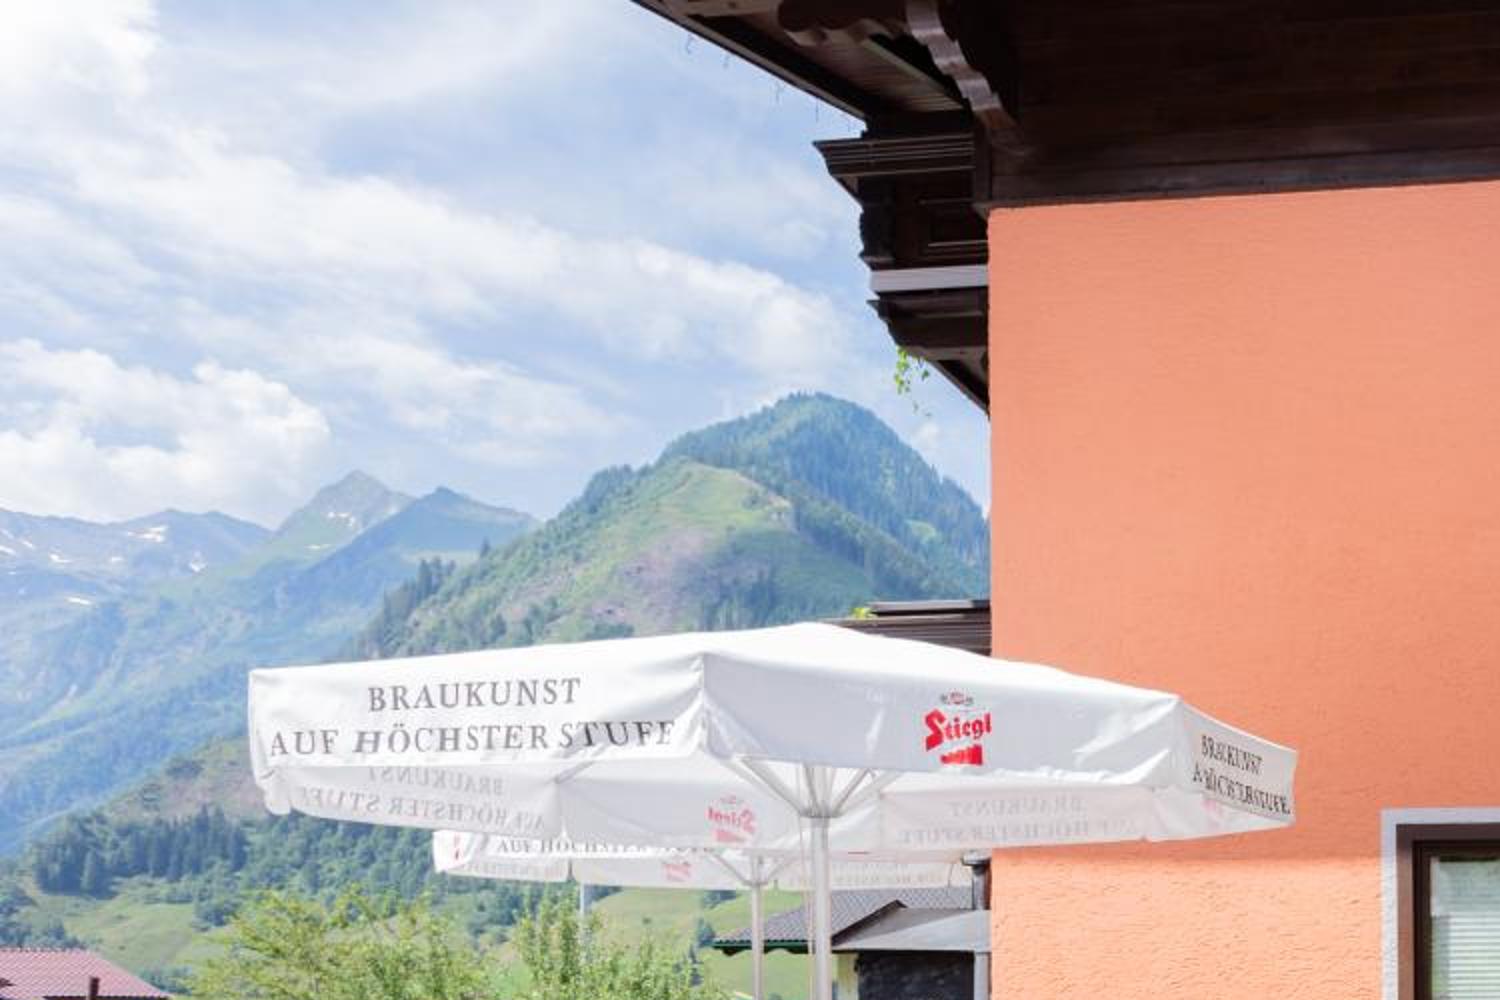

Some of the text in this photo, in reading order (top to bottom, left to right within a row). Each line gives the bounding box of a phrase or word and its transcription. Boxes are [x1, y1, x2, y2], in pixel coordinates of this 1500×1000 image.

[367, 677, 581, 712] BRAUKUNST
[270, 720, 675, 757] AUF HÖCHSTER STUFE
[925, 707, 991, 752] Stiegl
